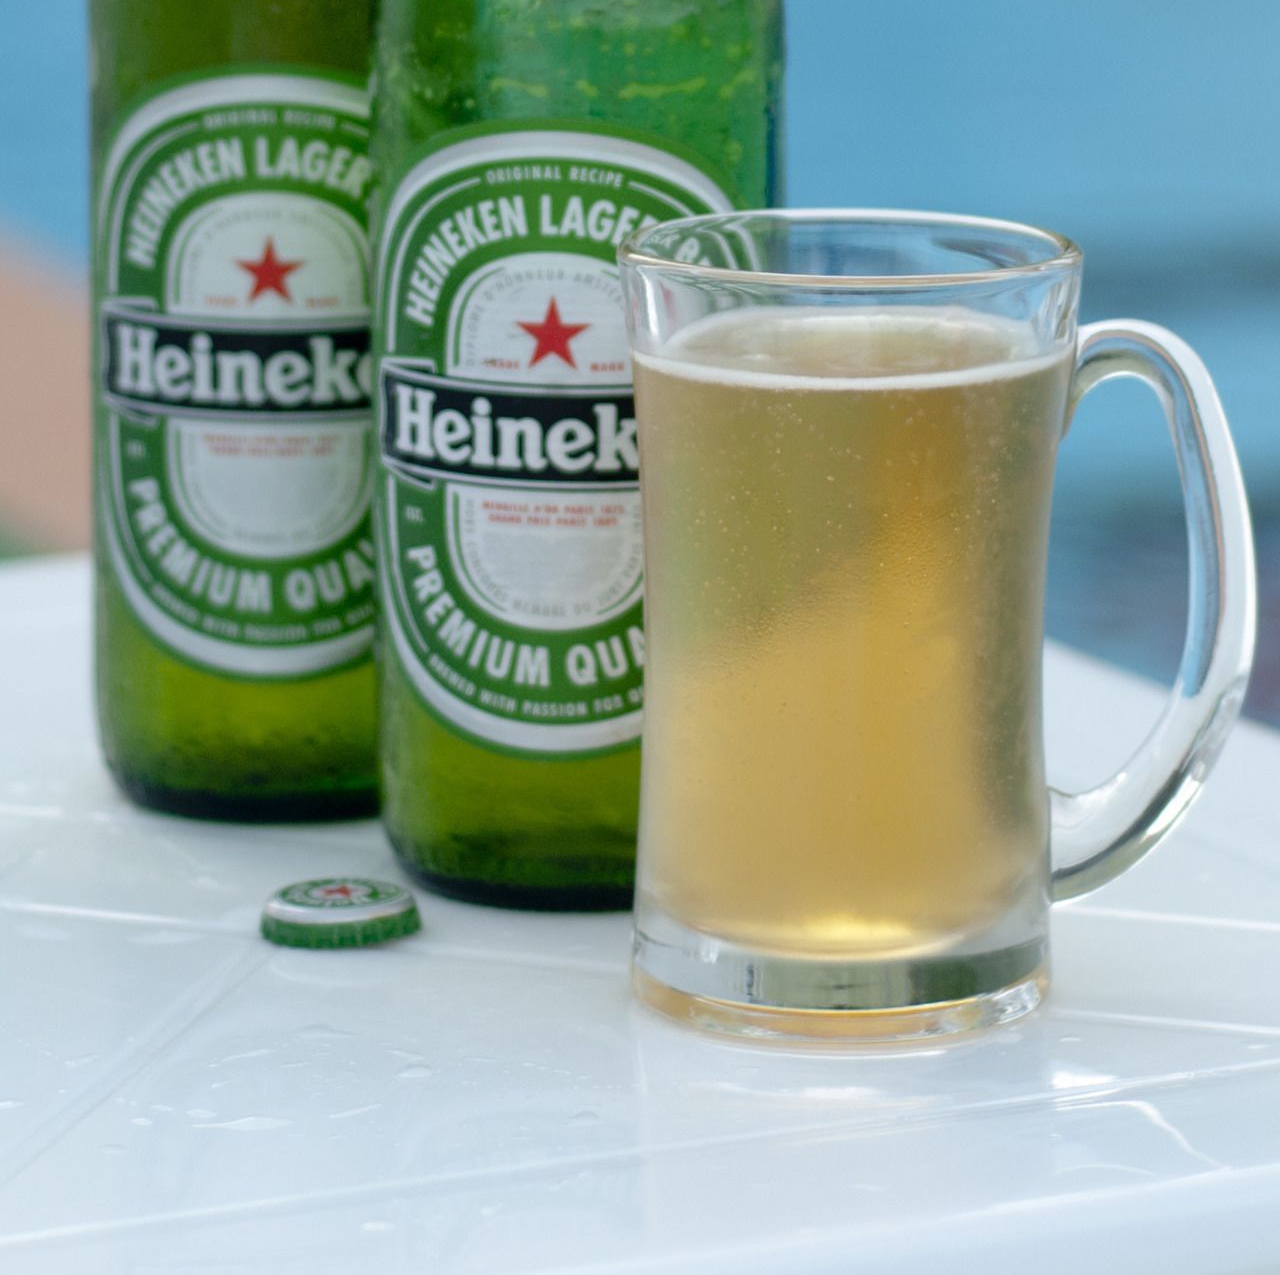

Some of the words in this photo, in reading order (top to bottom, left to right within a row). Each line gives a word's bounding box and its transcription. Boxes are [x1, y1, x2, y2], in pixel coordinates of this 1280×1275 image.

[125, 136, 249, 270] HEINEKEN
[484, 166, 561, 184] ORIGINAL
[569, 166, 624, 187] RECIPE
[404, 195, 529, 327] HEINEKEN
[128, 478, 272, 615] PREMIUM
[407, 545, 551, 688] PREMIUM
[480, 687, 517, 713] WITH
[523, 700, 589, 718] PASSION
[594, 693, 625, 713] FOR
